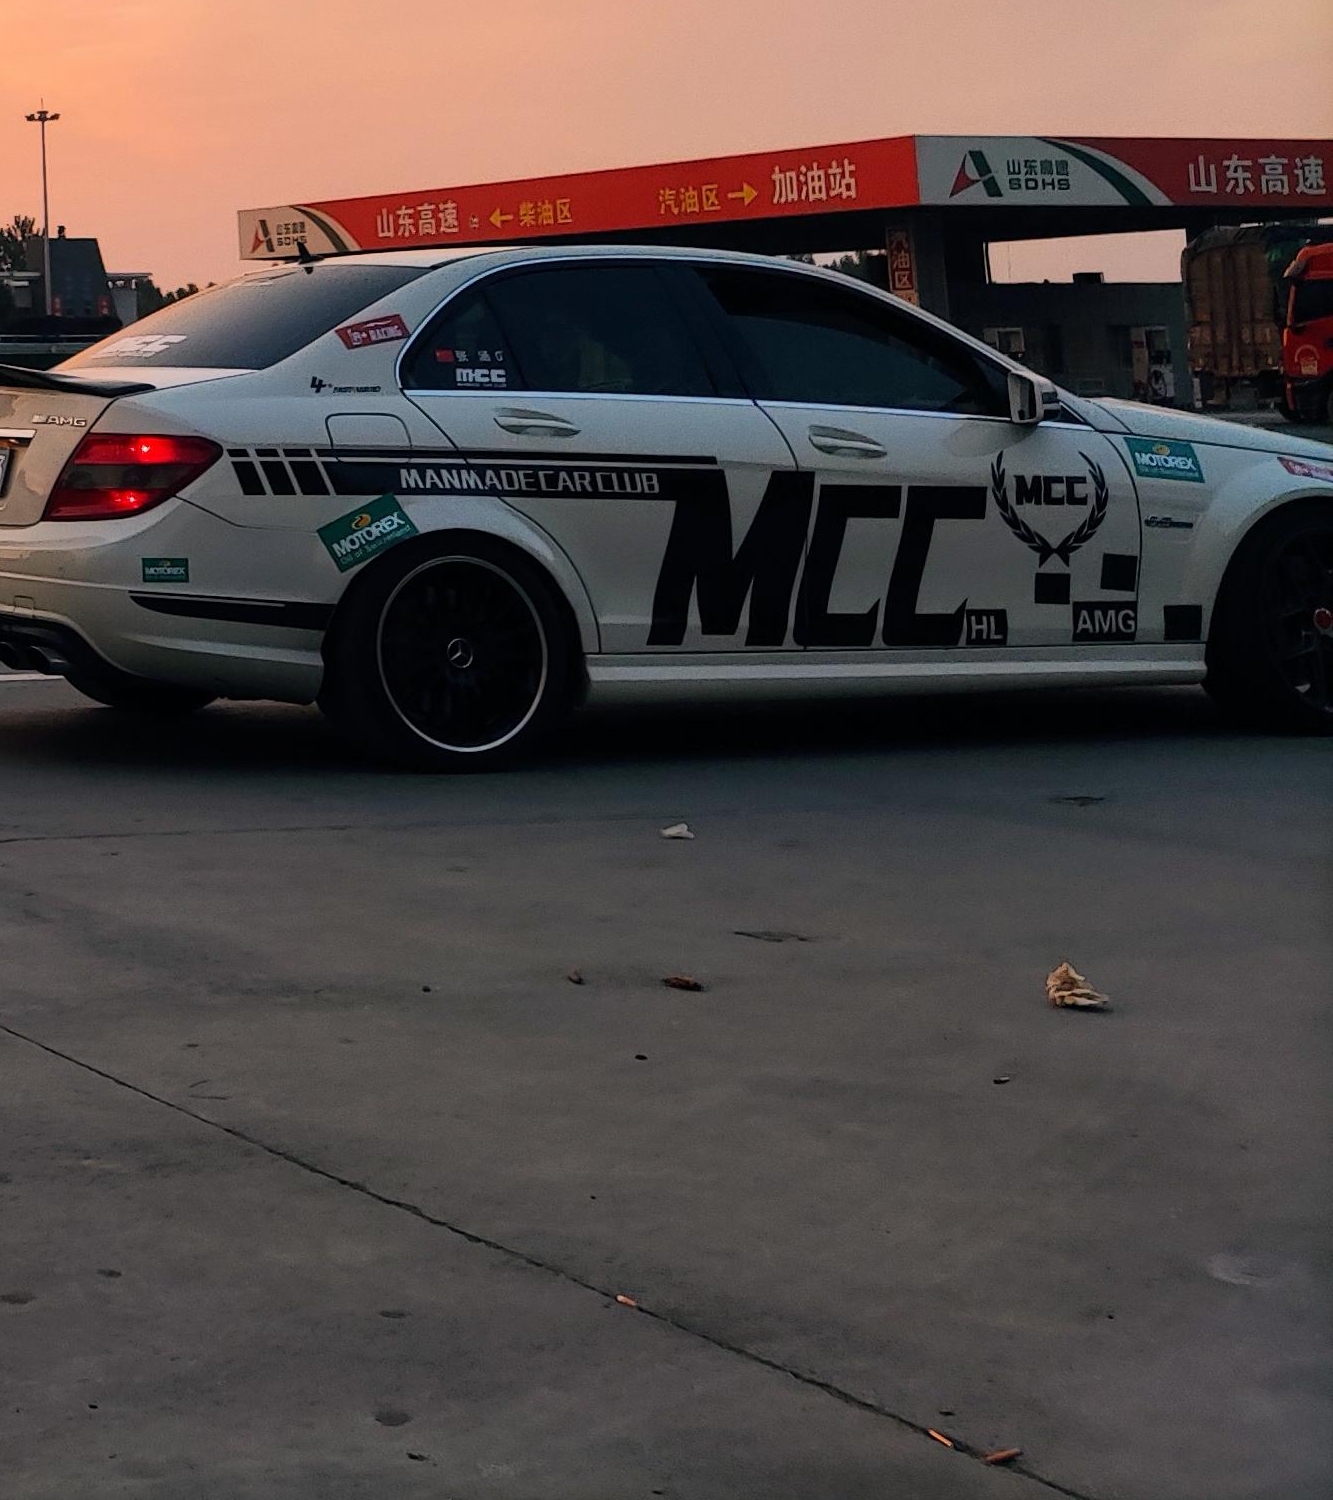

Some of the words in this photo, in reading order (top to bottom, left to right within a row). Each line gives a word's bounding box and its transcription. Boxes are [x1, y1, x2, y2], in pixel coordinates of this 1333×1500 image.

[771, 157, 858, 204] 加油站
[1006, 158, 1070, 176] 山东高速
[1188, 153, 1328, 197] 山东高速
[1008, 176, 1071, 191] SDHS
[658, 183, 722, 216] 汽油区
[376, 199, 460, 239] 山东高速
[518, 198, 574, 228] 柴油区
[46, 415, 87, 427] AMG
[1135, 452, 1197, 472] MOTOREX
[399, 468, 536, 491] MANMADE
[538, 470, 593, 492] CAR
[595, 472, 660, 494] CLUB
[1013, 474, 1089, 506] MCC
[332, 511, 406, 558] MOTOREX
[646, 469, 988, 647] MCC
[970, 615, 1004, 640] HL
[1076, 609, 1136, 634] AMG
